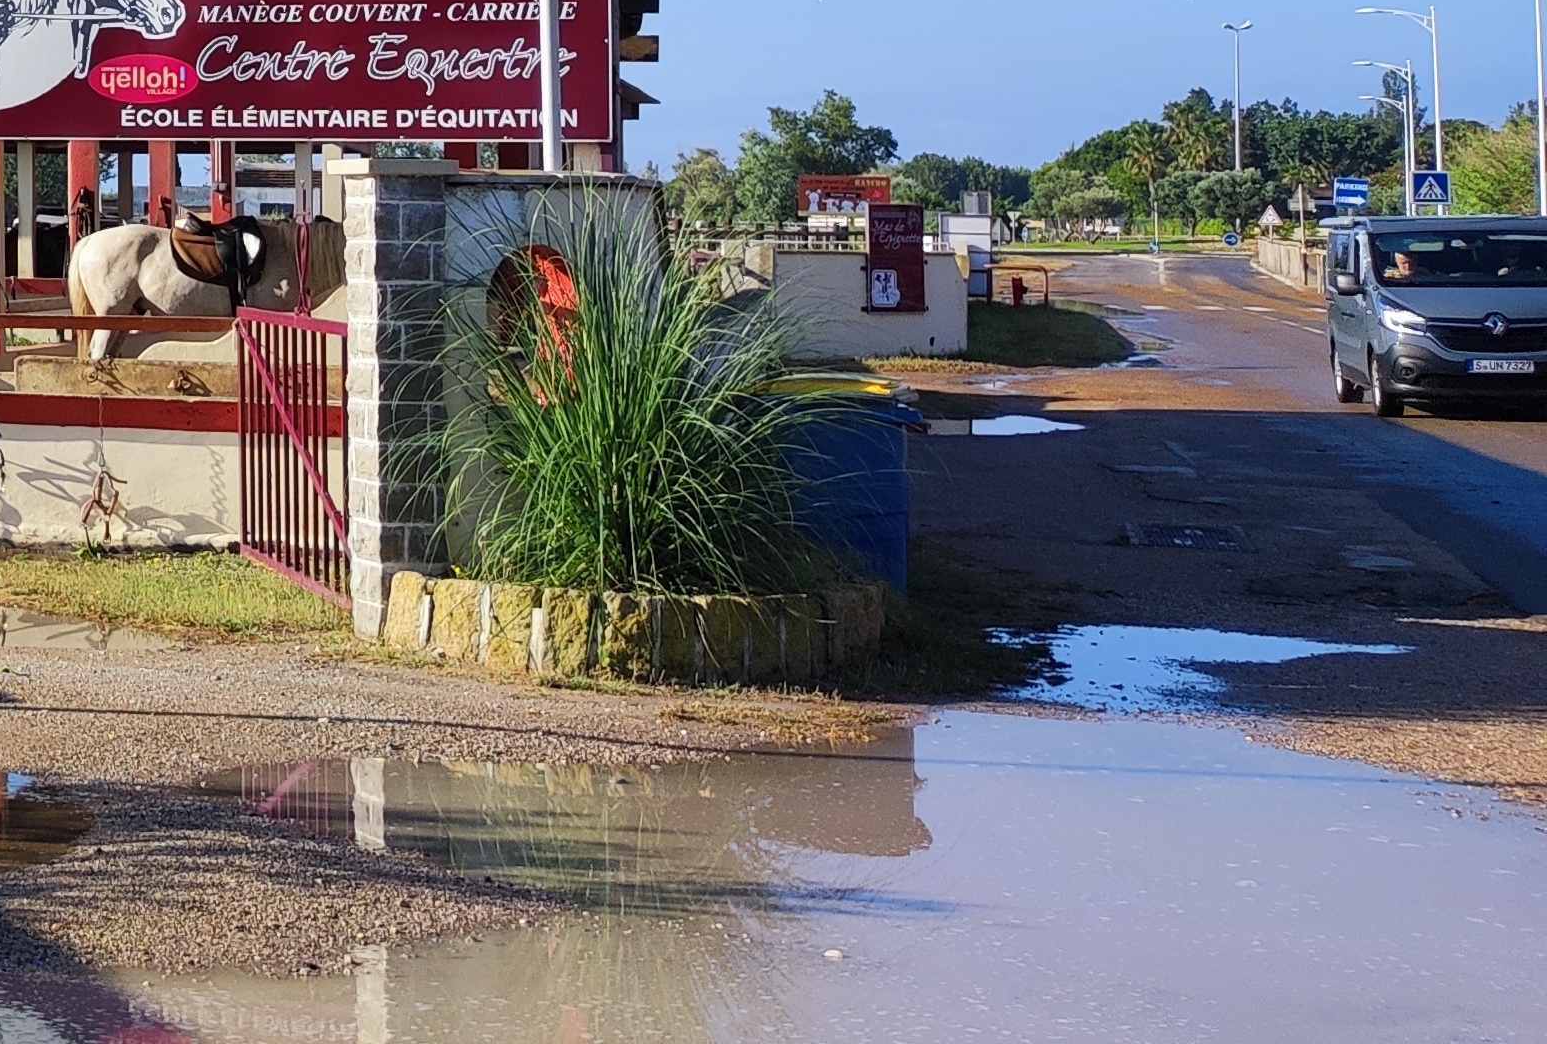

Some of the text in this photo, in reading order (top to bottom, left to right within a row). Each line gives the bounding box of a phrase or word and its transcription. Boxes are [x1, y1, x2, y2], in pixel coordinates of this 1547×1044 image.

[197, 0, 304, 24] MANÈGE
[308, 3, 428, 23] COUVERT
[195, 34, 356, 82] Centre
[100, 65, 186, 95] yelloh!
[120, 104, 578, 129] ÉCOLE ÉLÉMENTAIRE D'ÉQUITATIN
